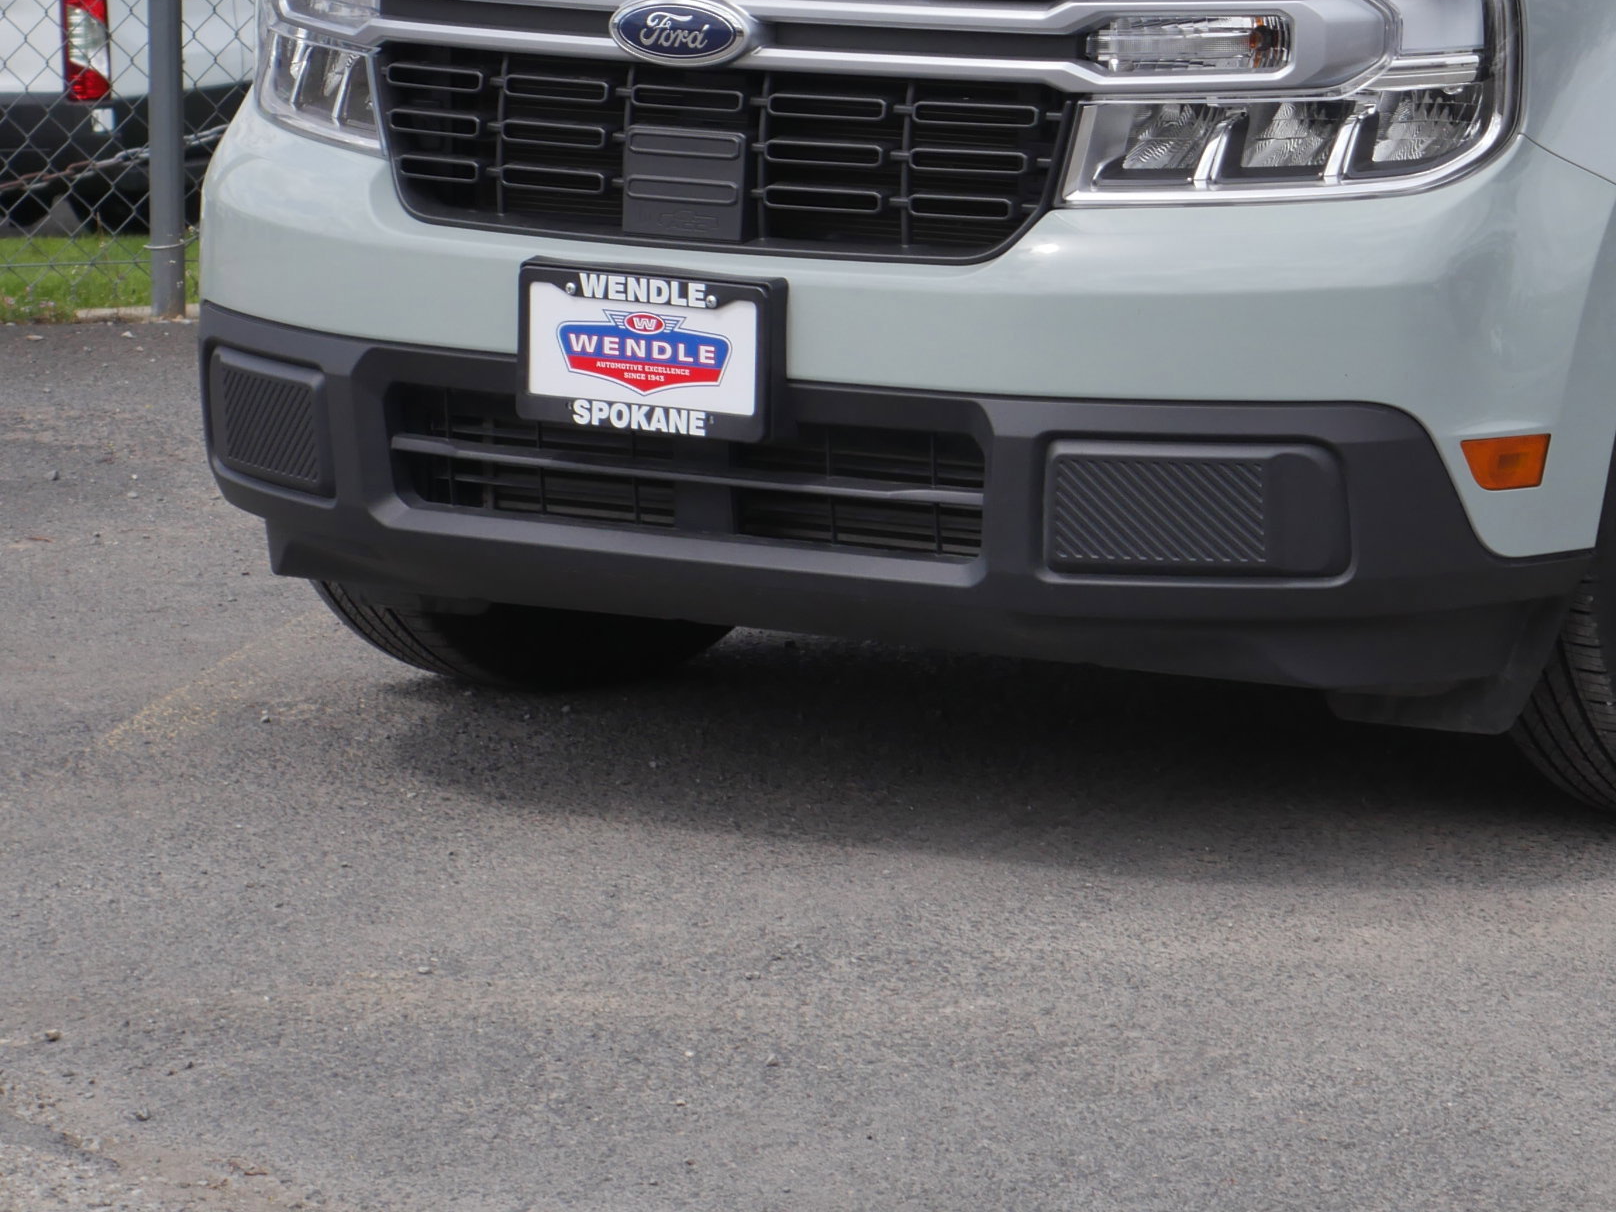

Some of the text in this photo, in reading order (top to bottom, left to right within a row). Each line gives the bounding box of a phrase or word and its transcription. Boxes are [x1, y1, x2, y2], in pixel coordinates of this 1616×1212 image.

[640, 11, 710, 49] Ford
[579, 273, 707, 308] WENDLE
[569, 333, 716, 364] WENDLE
[596, 361, 691, 376] AUTOMOTIVE EXCELLENCE
[624, 372, 665, 382] SINCE 1943
[571, 399, 706, 437] SPOKANE
